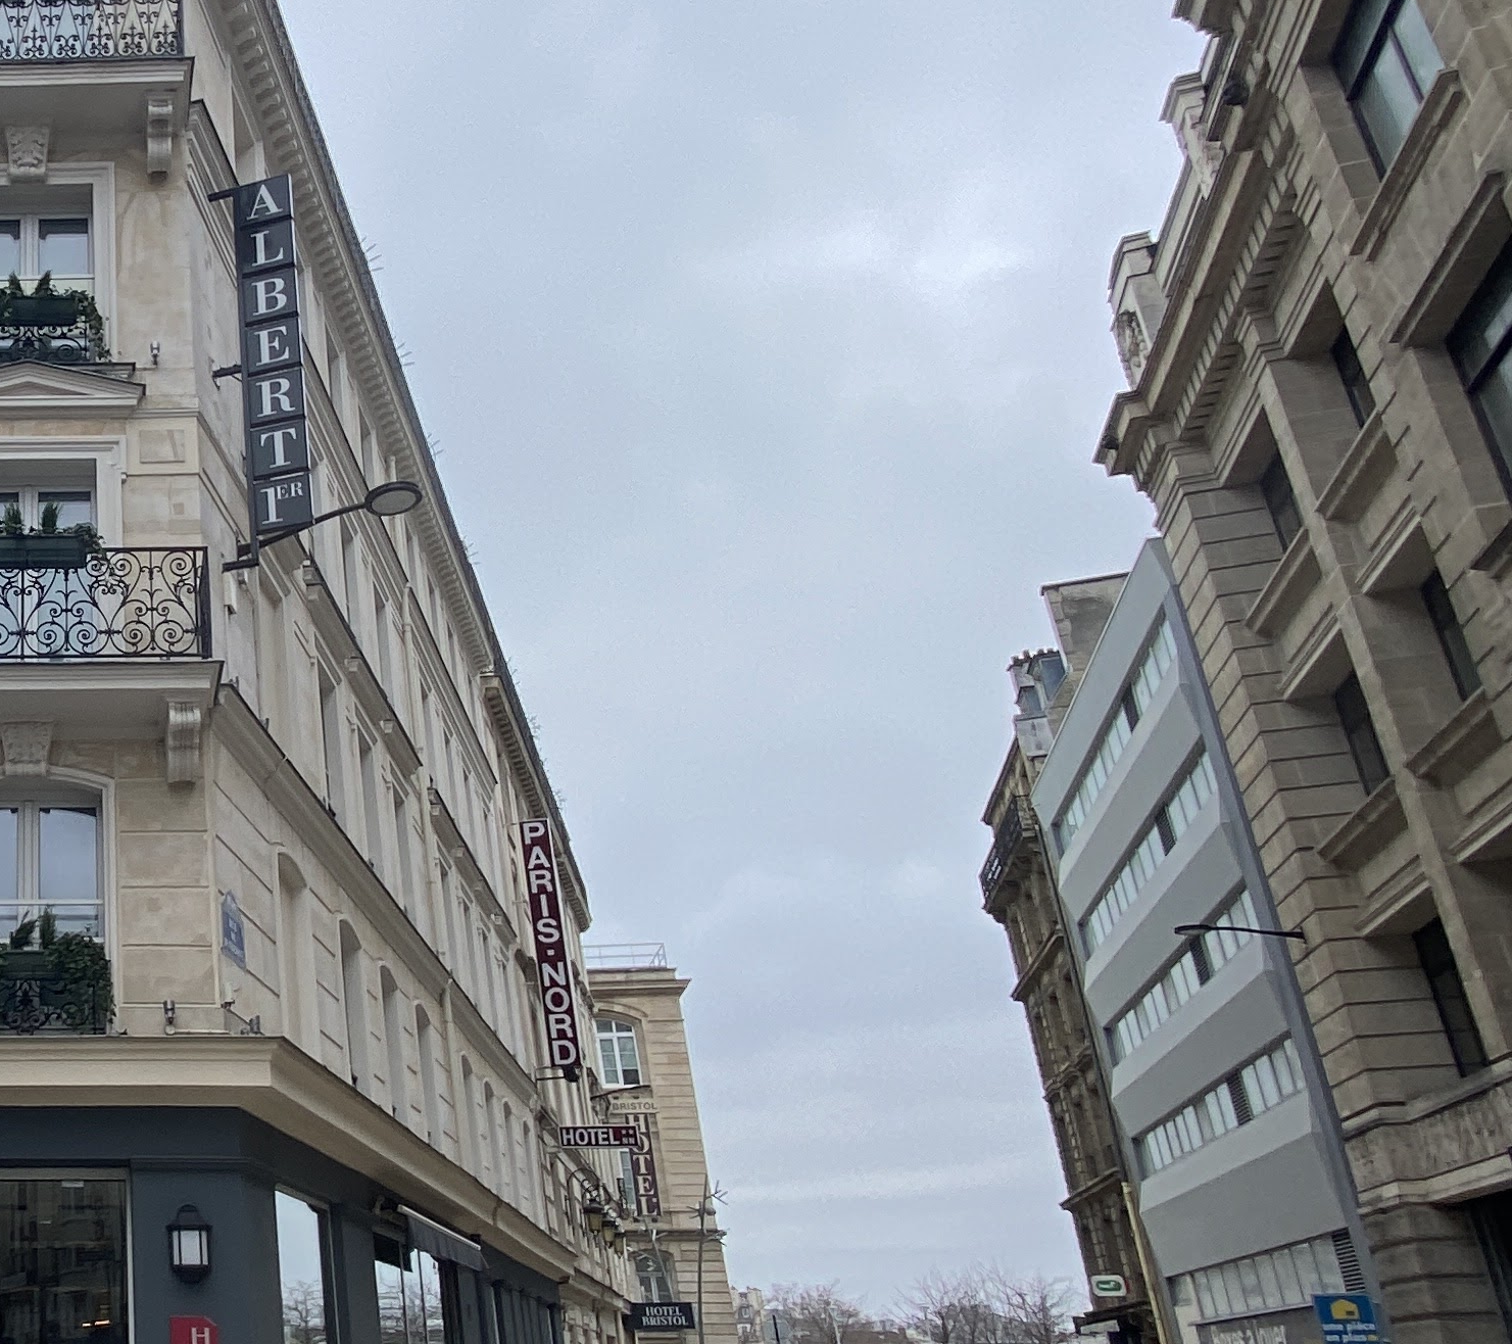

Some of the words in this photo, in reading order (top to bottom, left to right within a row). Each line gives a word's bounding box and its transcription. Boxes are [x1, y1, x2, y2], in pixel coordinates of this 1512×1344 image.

[246, 184, 297, 468] ALBERT
[612, 1102, 658, 1111] BRISTOL
[562, 1128, 621, 1146] HOTEL
[645, 1306, 683, 1316] HOTEL
[641, 1316, 689, 1326] BRISTOL
